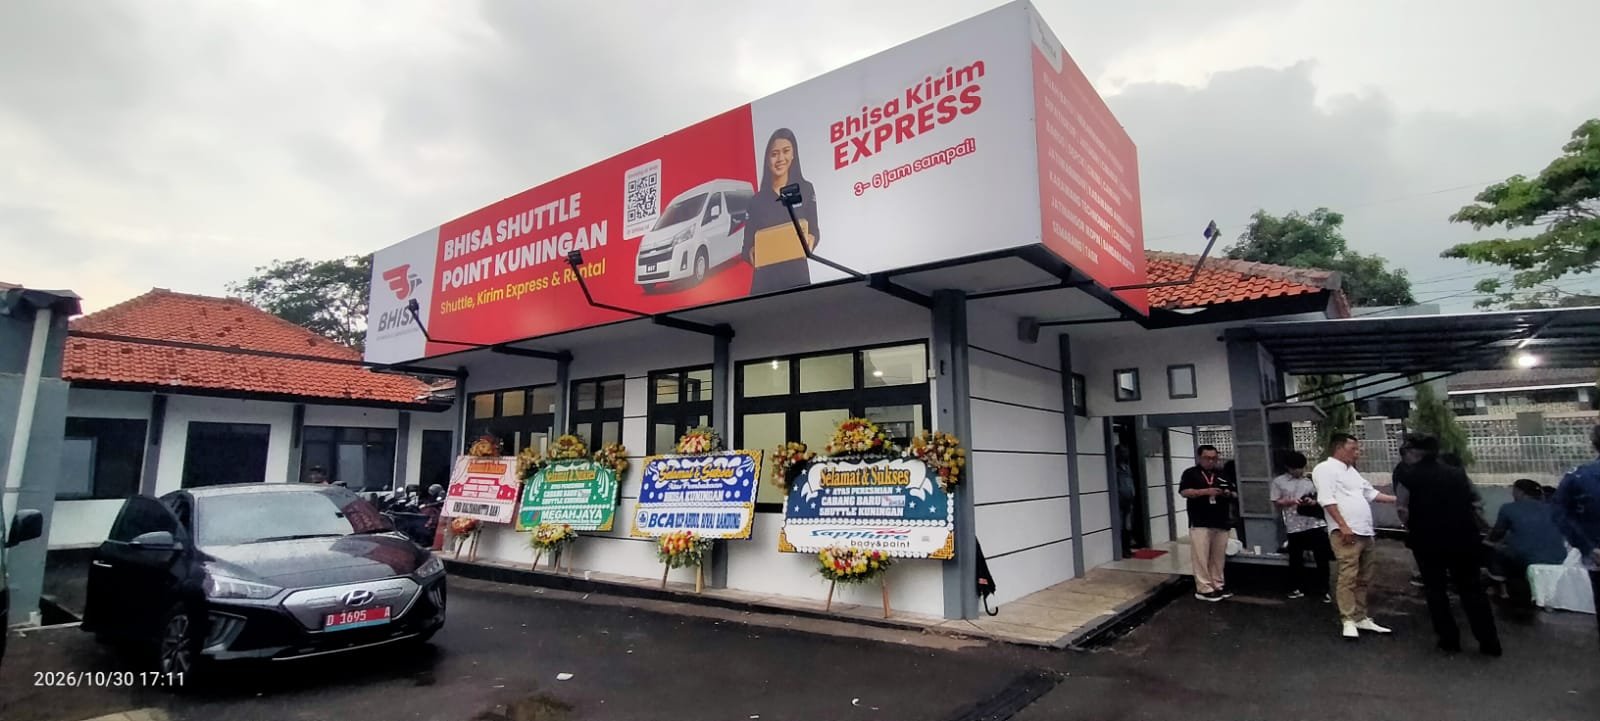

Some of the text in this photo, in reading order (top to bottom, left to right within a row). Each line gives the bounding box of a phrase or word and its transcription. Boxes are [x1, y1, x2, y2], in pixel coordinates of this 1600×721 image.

[830, 60, 985, 144] Bhisa Kirim
[834, 83, 983, 170] EXPRESS
[871, 173, 883, 189] 6
[883, 164, 912, 187] jam
[913, 138, 976, 175] sampai!
[443, 192, 582, 262] BHISA SHUTTLE
[441, 219, 608, 292] POINT KUNINGAN
[440, 256, 606, 315] Shuttle, Kirim Express & Rental
[821, 465, 910, 487] Selamat & Sukses
[821, 495, 856, 506] CABANG
[856, 495, 881, 506] BARU
[541, 509, 603, 521] MEGAHJAYA
[648, 512, 674, 528] BCA
[819, 507, 904, 517] SHUTTLE KUNINGAN
[850, 539, 910, 548] body&paint
[326, 606, 391, 626] D 1695 A
